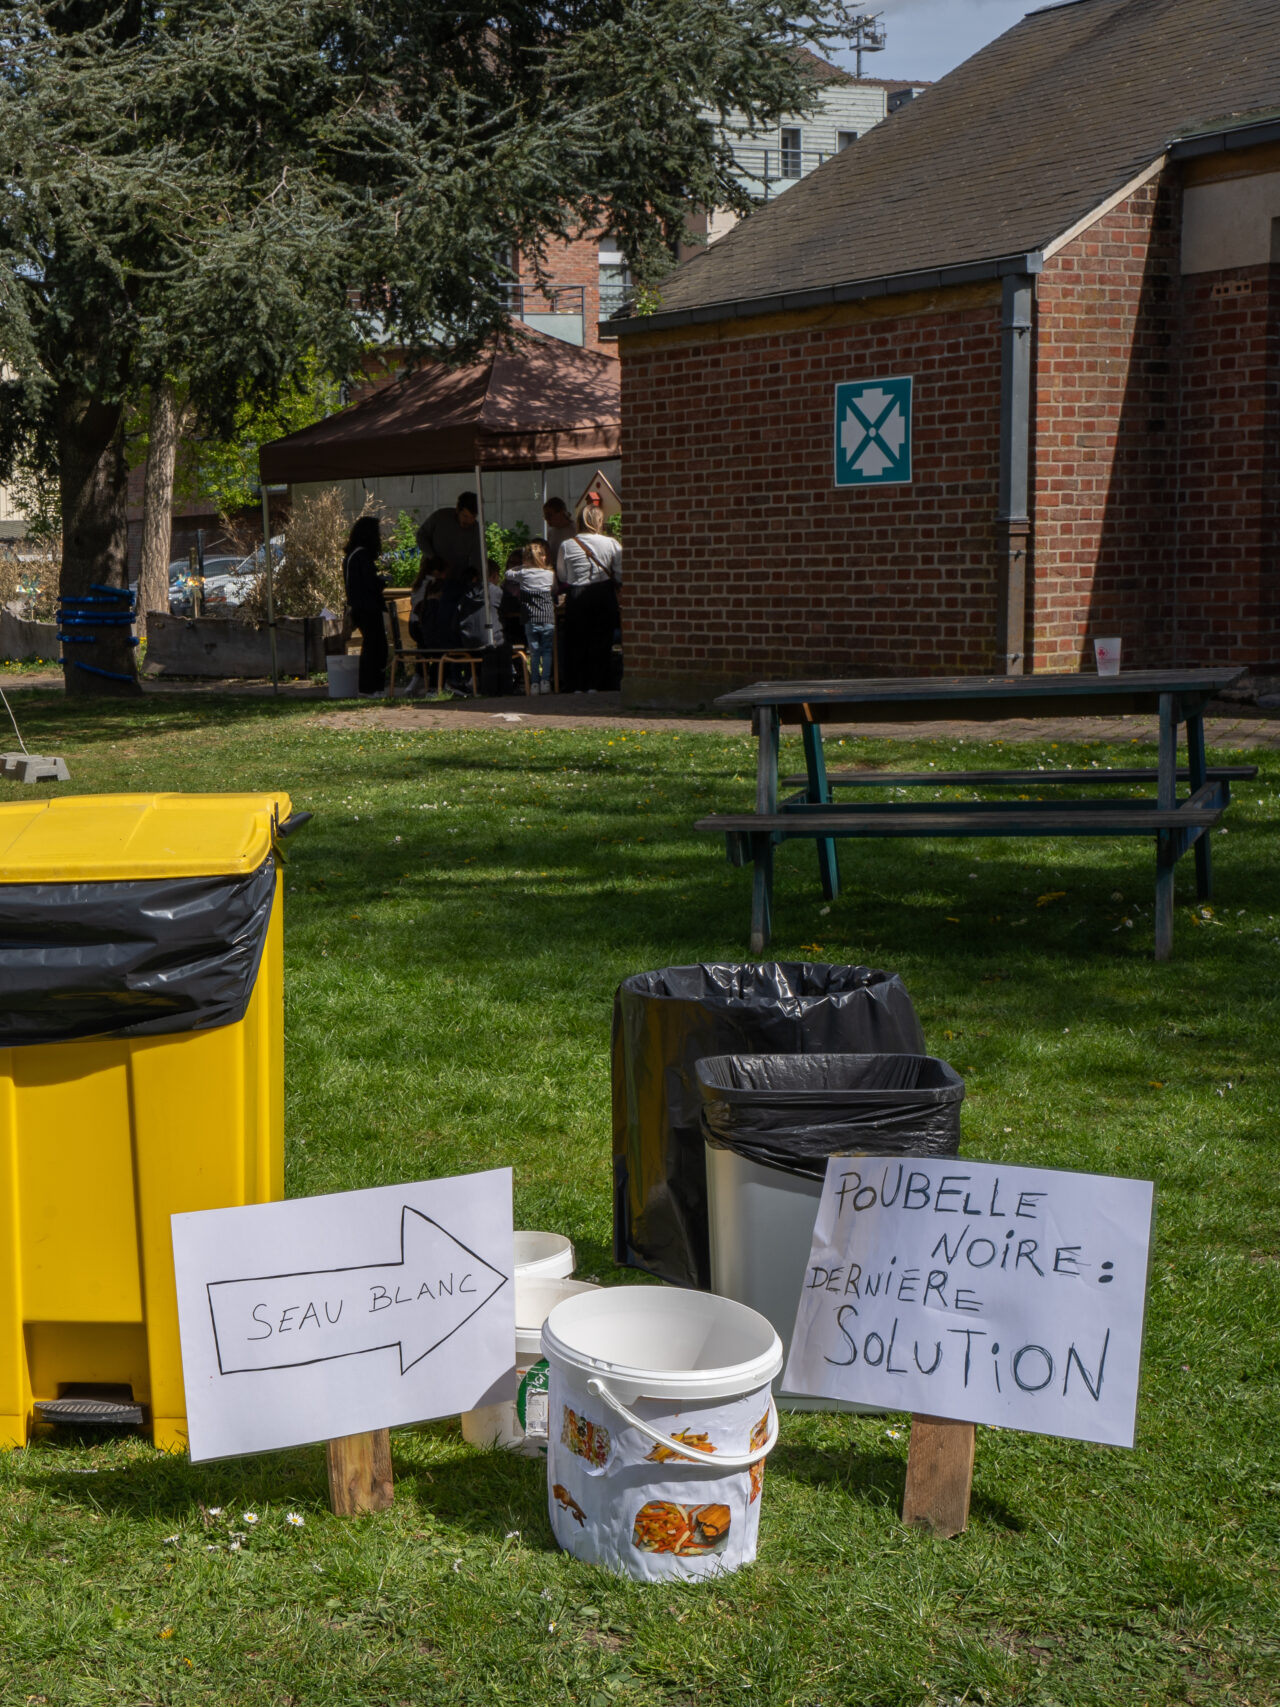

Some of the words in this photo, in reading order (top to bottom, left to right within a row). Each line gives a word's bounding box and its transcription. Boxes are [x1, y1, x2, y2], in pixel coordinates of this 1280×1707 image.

[835, 1164, 1048, 1219] POUBELLE
[247, 1299, 343, 1340] SEAU
[369, 1273, 477, 1313] BLANC
